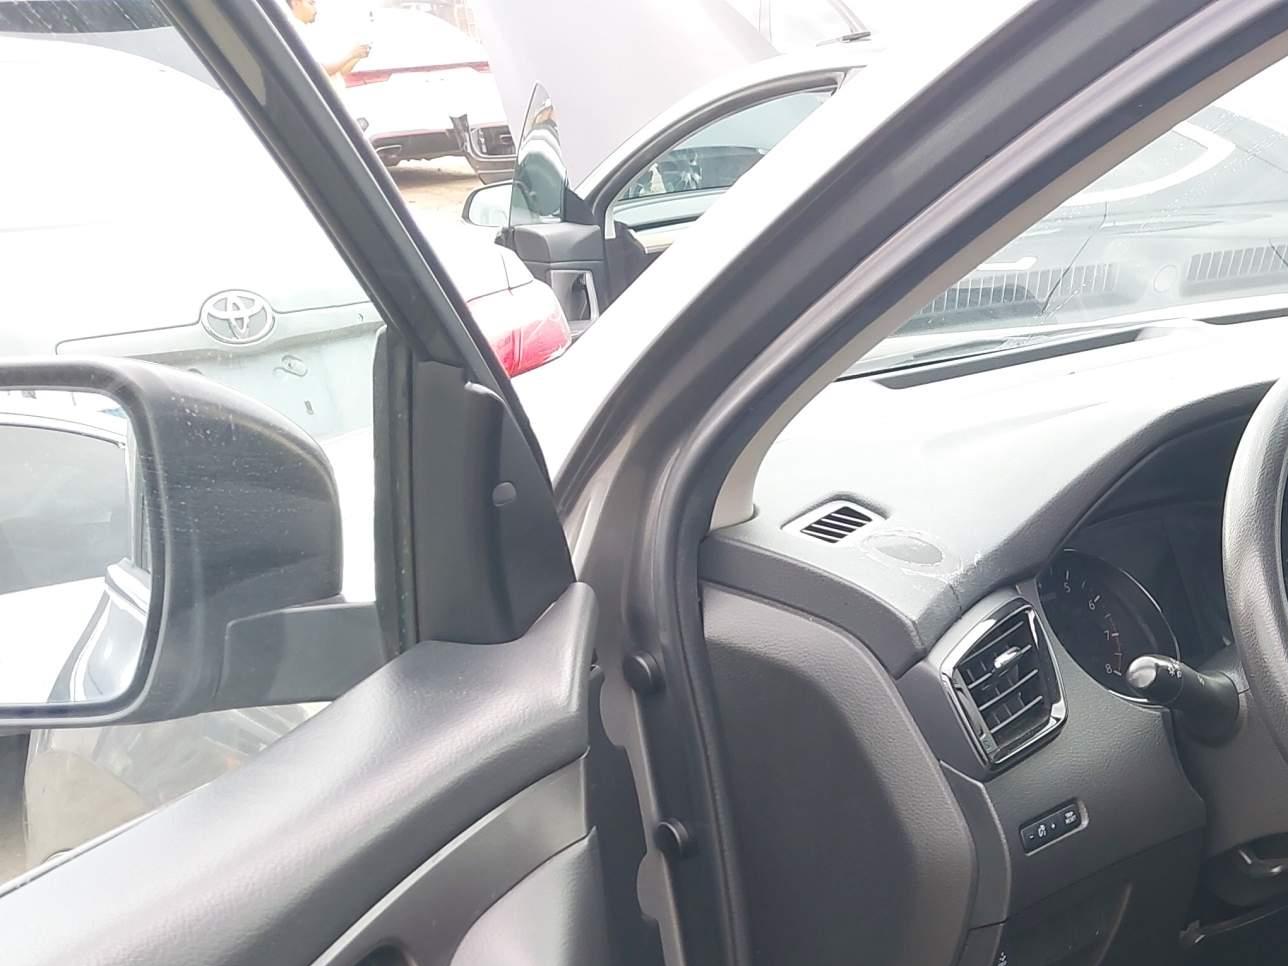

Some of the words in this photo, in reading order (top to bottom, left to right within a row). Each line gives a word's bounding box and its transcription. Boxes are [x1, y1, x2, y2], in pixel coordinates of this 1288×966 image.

[1063, 582, 1071, 593] 5
[1088, 600, 1096, 610] 6
[1103, 630, 1111, 641] 7
[1105, 663, 1113, 674] 8
